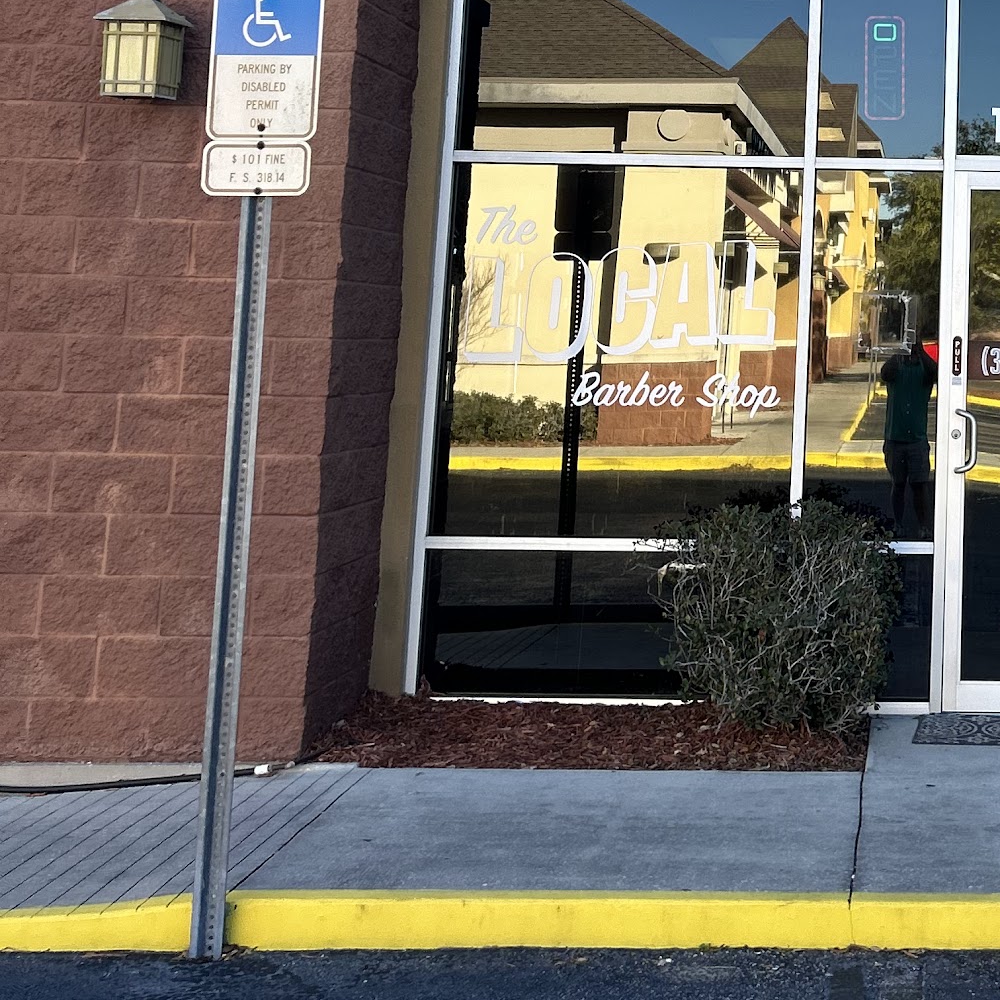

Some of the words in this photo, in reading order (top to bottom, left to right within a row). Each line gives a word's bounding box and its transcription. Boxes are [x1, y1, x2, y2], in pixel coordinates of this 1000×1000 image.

[237, 63, 276, 74] PARKING
[279, 64, 292, 74] BY
[241, 81, 286, 92] DISABLED
[245, 100, 279, 110] PERMIT
[265, 154, 286, 165] FINE
[257, 172, 285, 183] 318.14
[476, 204, 538, 245] The
[464, 240, 776, 363] LOCAL
[571, 371, 685, 408] Barber
[695, 373, 781, 419] Shop
